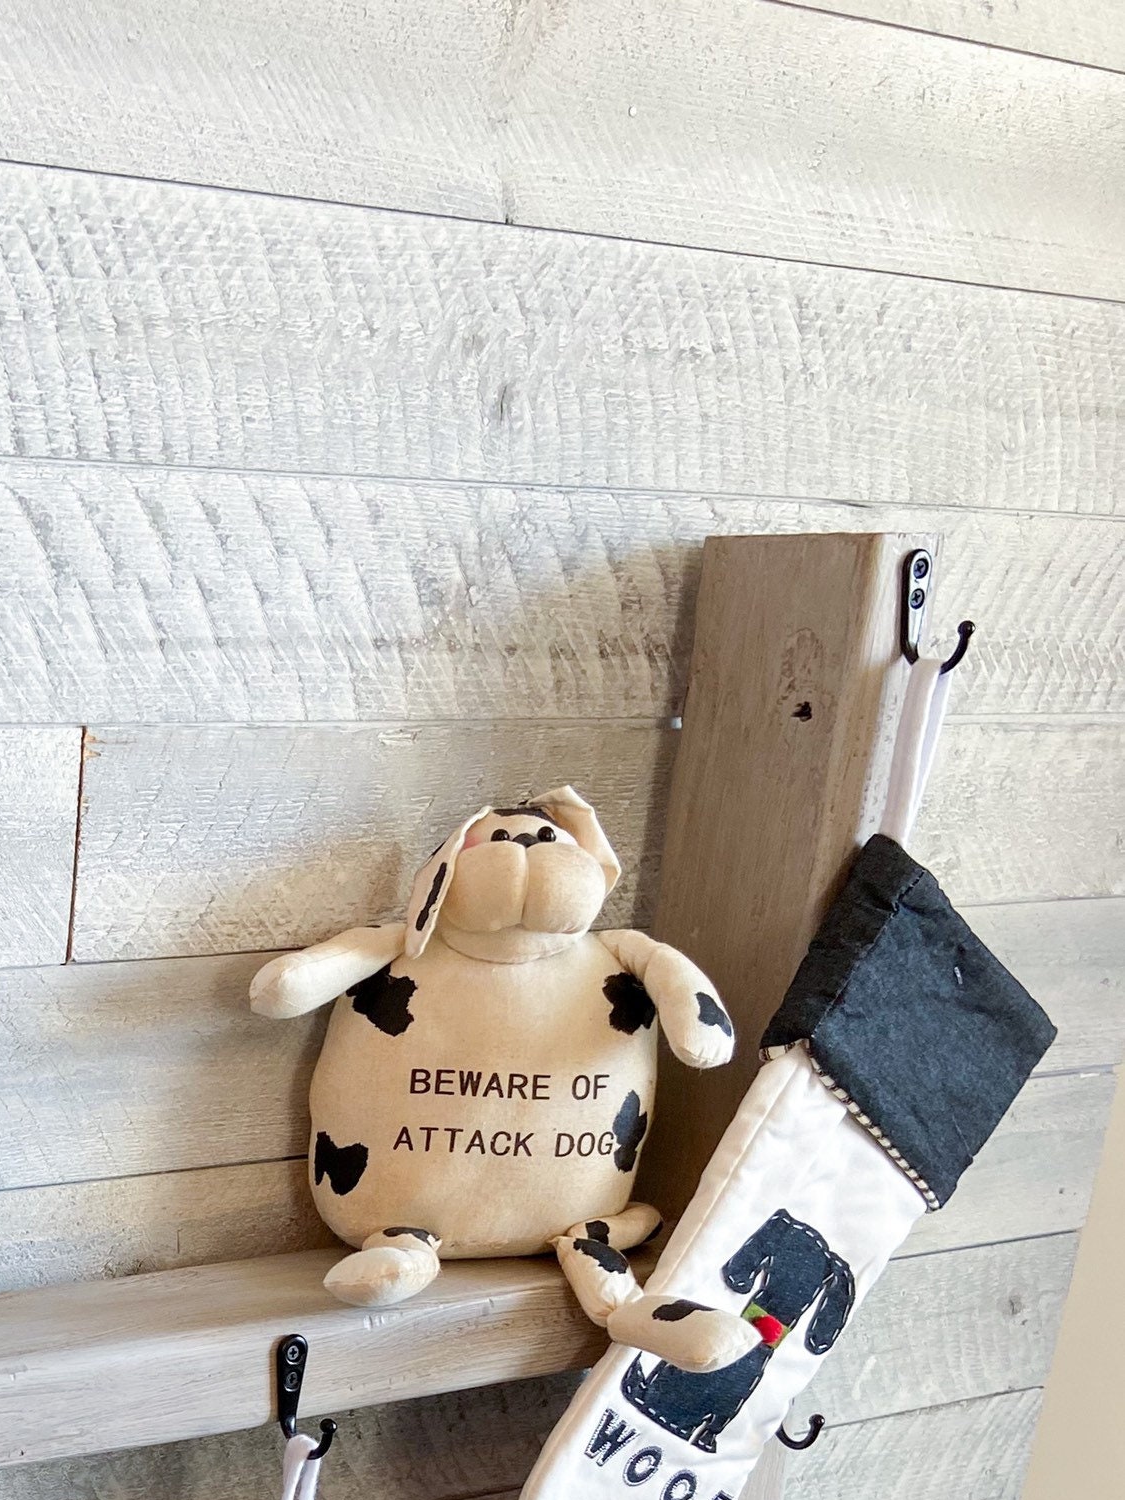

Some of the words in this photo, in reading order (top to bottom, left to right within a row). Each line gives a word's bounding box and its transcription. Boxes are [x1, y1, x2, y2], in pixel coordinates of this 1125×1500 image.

[409, 1067, 552, 1101] BEWARE
[571, 1073, 611, 1101] OF
[393, 1126, 534, 1158] ATTACK
[554, 1131, 615, 1157] DOG
